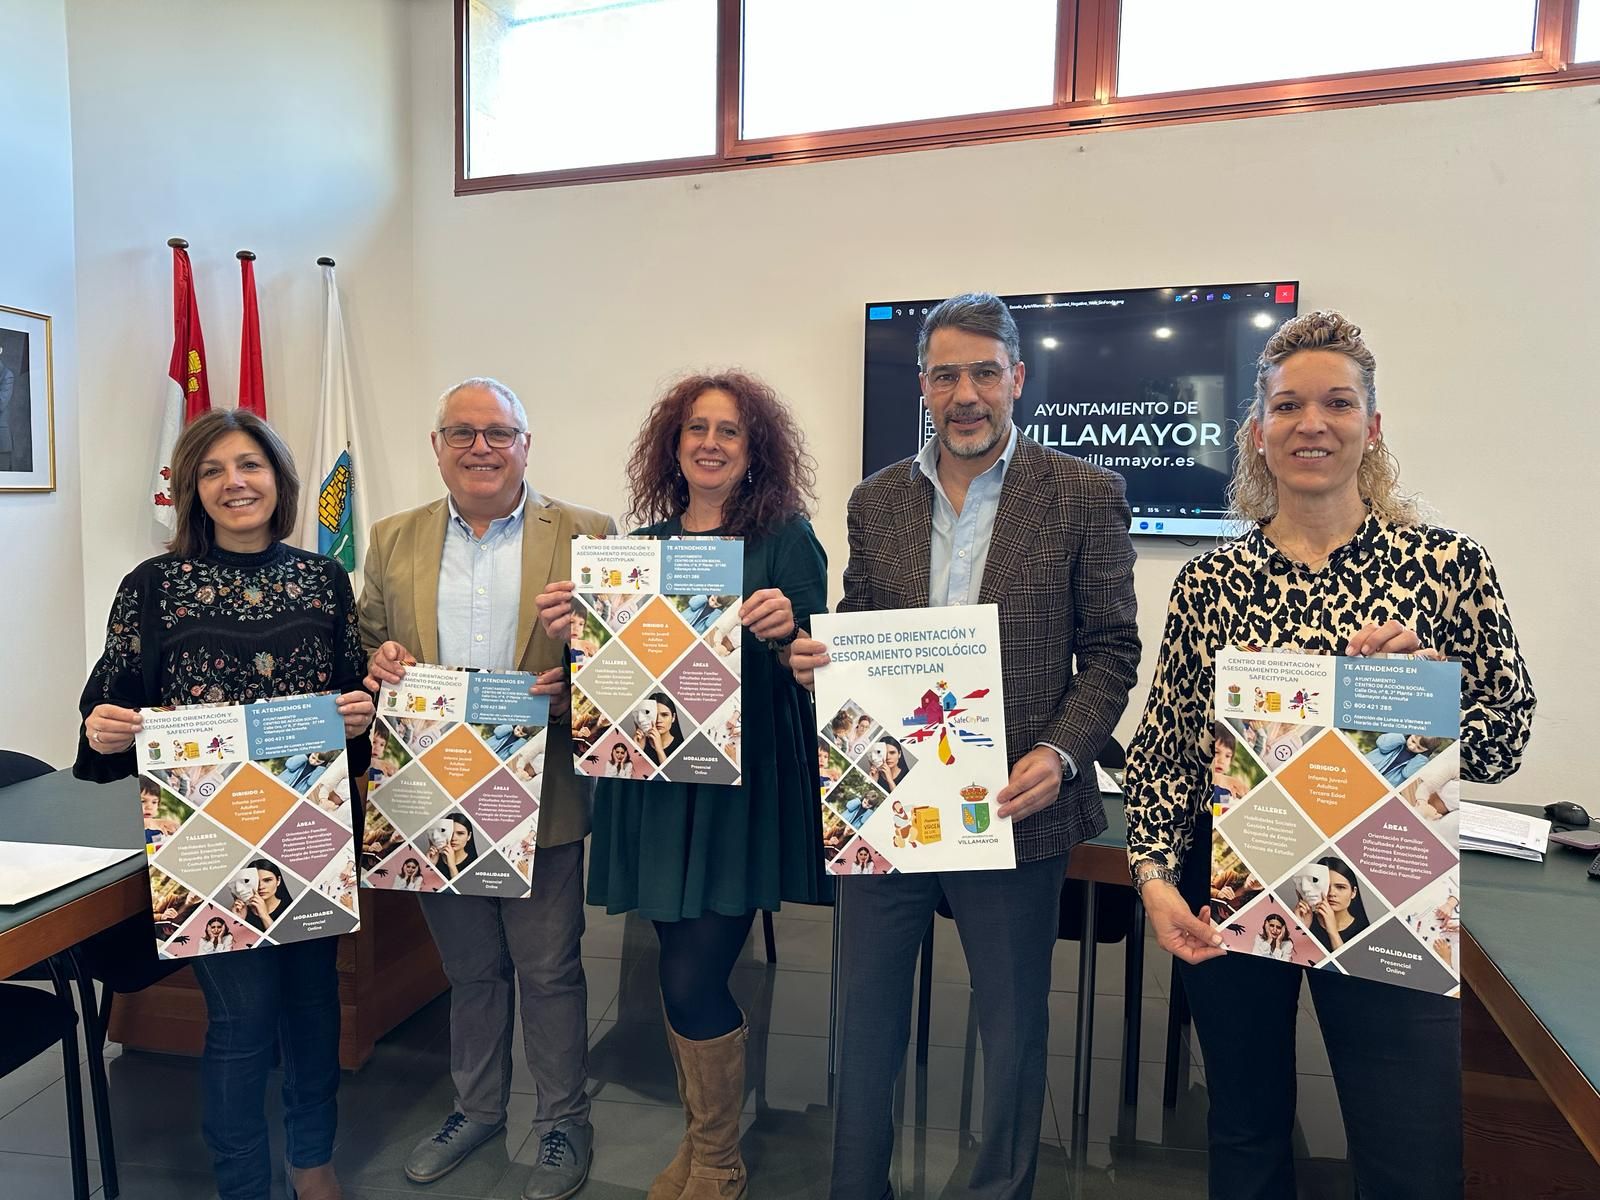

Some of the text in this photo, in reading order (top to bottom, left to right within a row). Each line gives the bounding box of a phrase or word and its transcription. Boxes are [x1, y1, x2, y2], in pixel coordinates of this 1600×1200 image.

[1034, 402, 1198, 416] AYUNTAMIENTO DE
[833, 627, 976, 646] CENTRO DE ORIENTACIÓN Y
[916, 643, 986, 658] PSICOLÓGICO
[1268, 660, 1314, 668] ORIENTACIÓN
[1354, 664, 1404, 673] ATENDEMOS
[868, 663, 944, 676] SAFECITYPLAN
[1222, 665, 1327, 677] ASESORAMIENTO PSICOLÓGICO
[1248, 674, 1299, 683] SAFECITYPLAN
[261, 704, 302, 714] ATENDEMOS
[183, 712, 226, 722] ORIENTACIÓN
[196, 717, 238, 726] PSICOLÓGICO
[167, 726, 214, 736] SAFECITYPLAN
[1309, 763, 1340, 772] DIRIGIDO
[1254, 805, 1287, 815] TALLERES
[1383, 822, 1408, 832] ÁREAS
[292, 910, 334, 920] MODALIDADES
[1368, 945, 1423, 961] MODALIDADES
[1380, 958, 1412, 970] Presencial
[1386, 966, 1406, 976] Online
